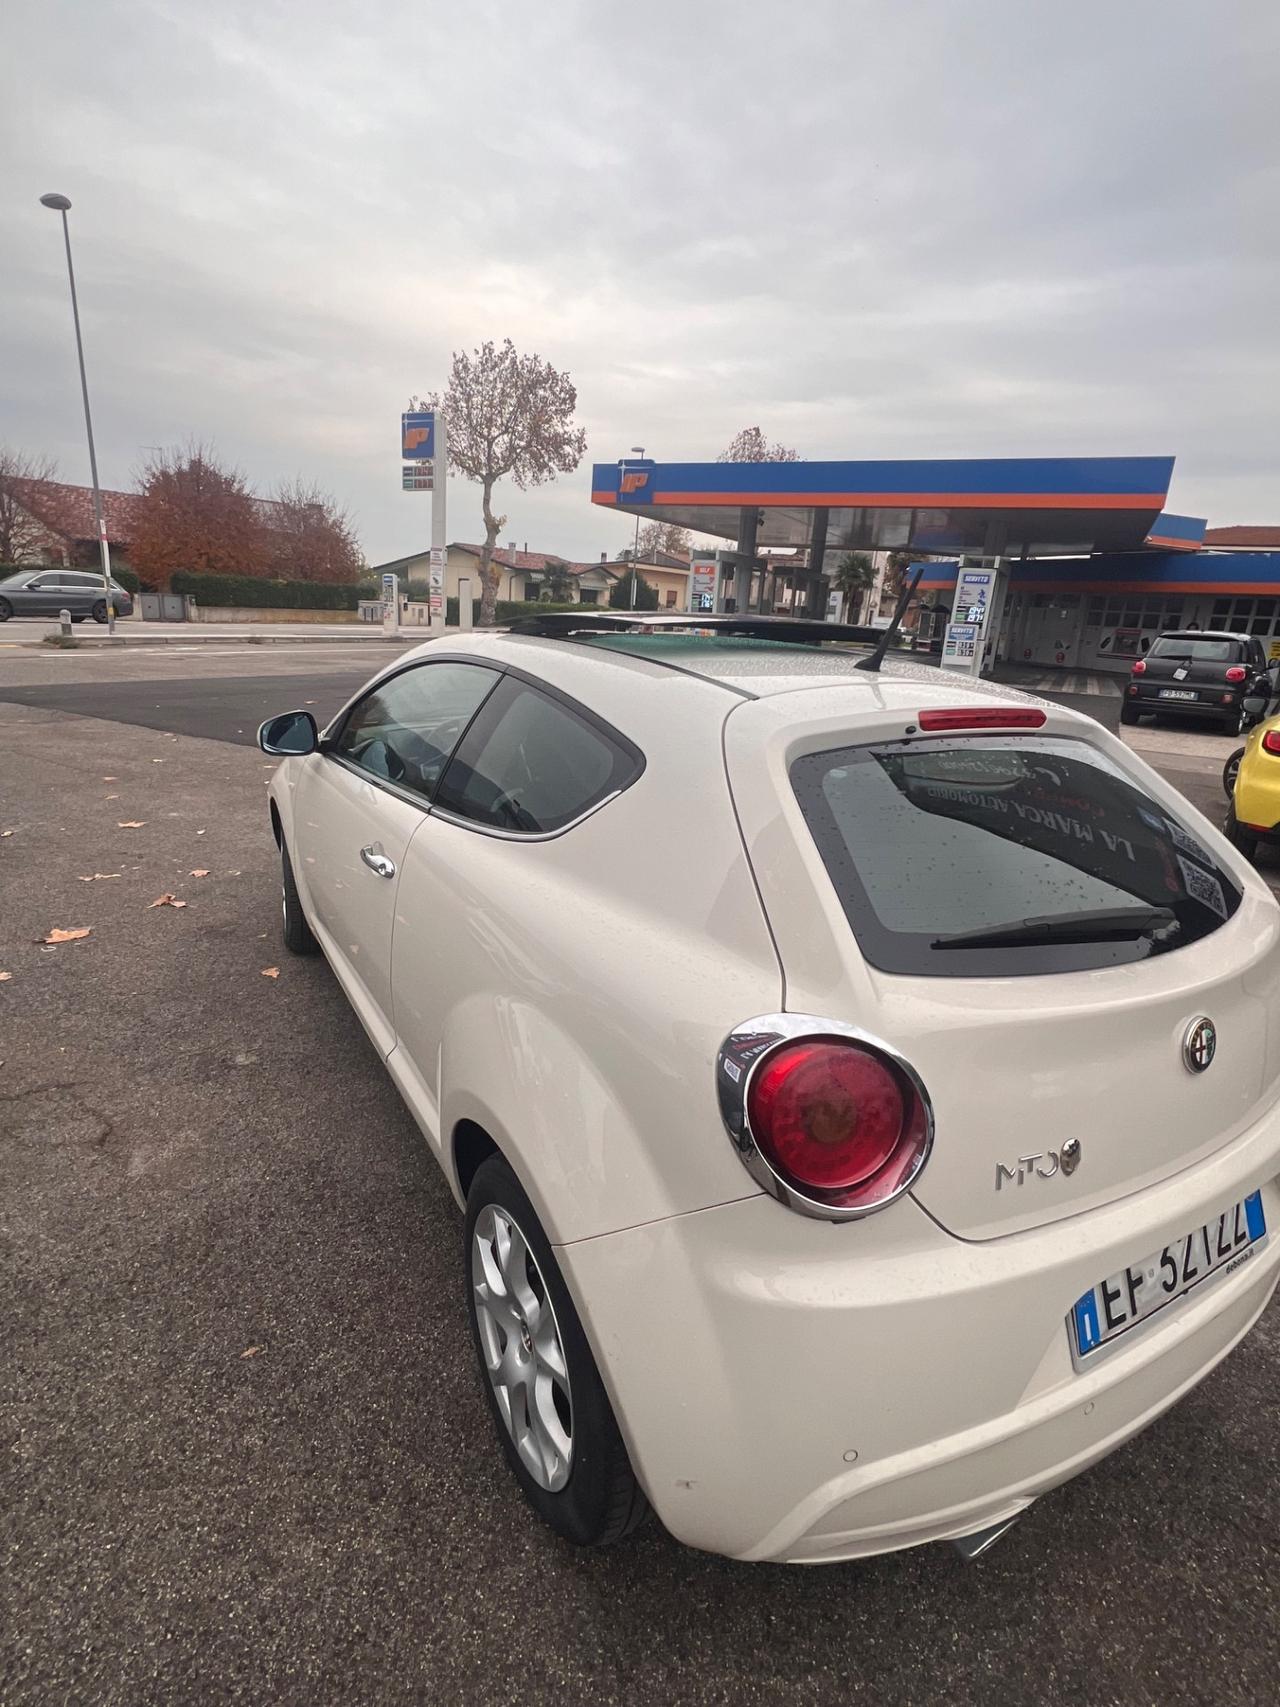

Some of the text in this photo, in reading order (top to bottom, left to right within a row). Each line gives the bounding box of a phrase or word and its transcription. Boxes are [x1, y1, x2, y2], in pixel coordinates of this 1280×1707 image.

[619, 473, 648, 493] IP
[1010, 799, 1095, 843] MARCA
[1099, 829, 1137, 862] LA
[1101, 1267, 1144, 1330] EF
